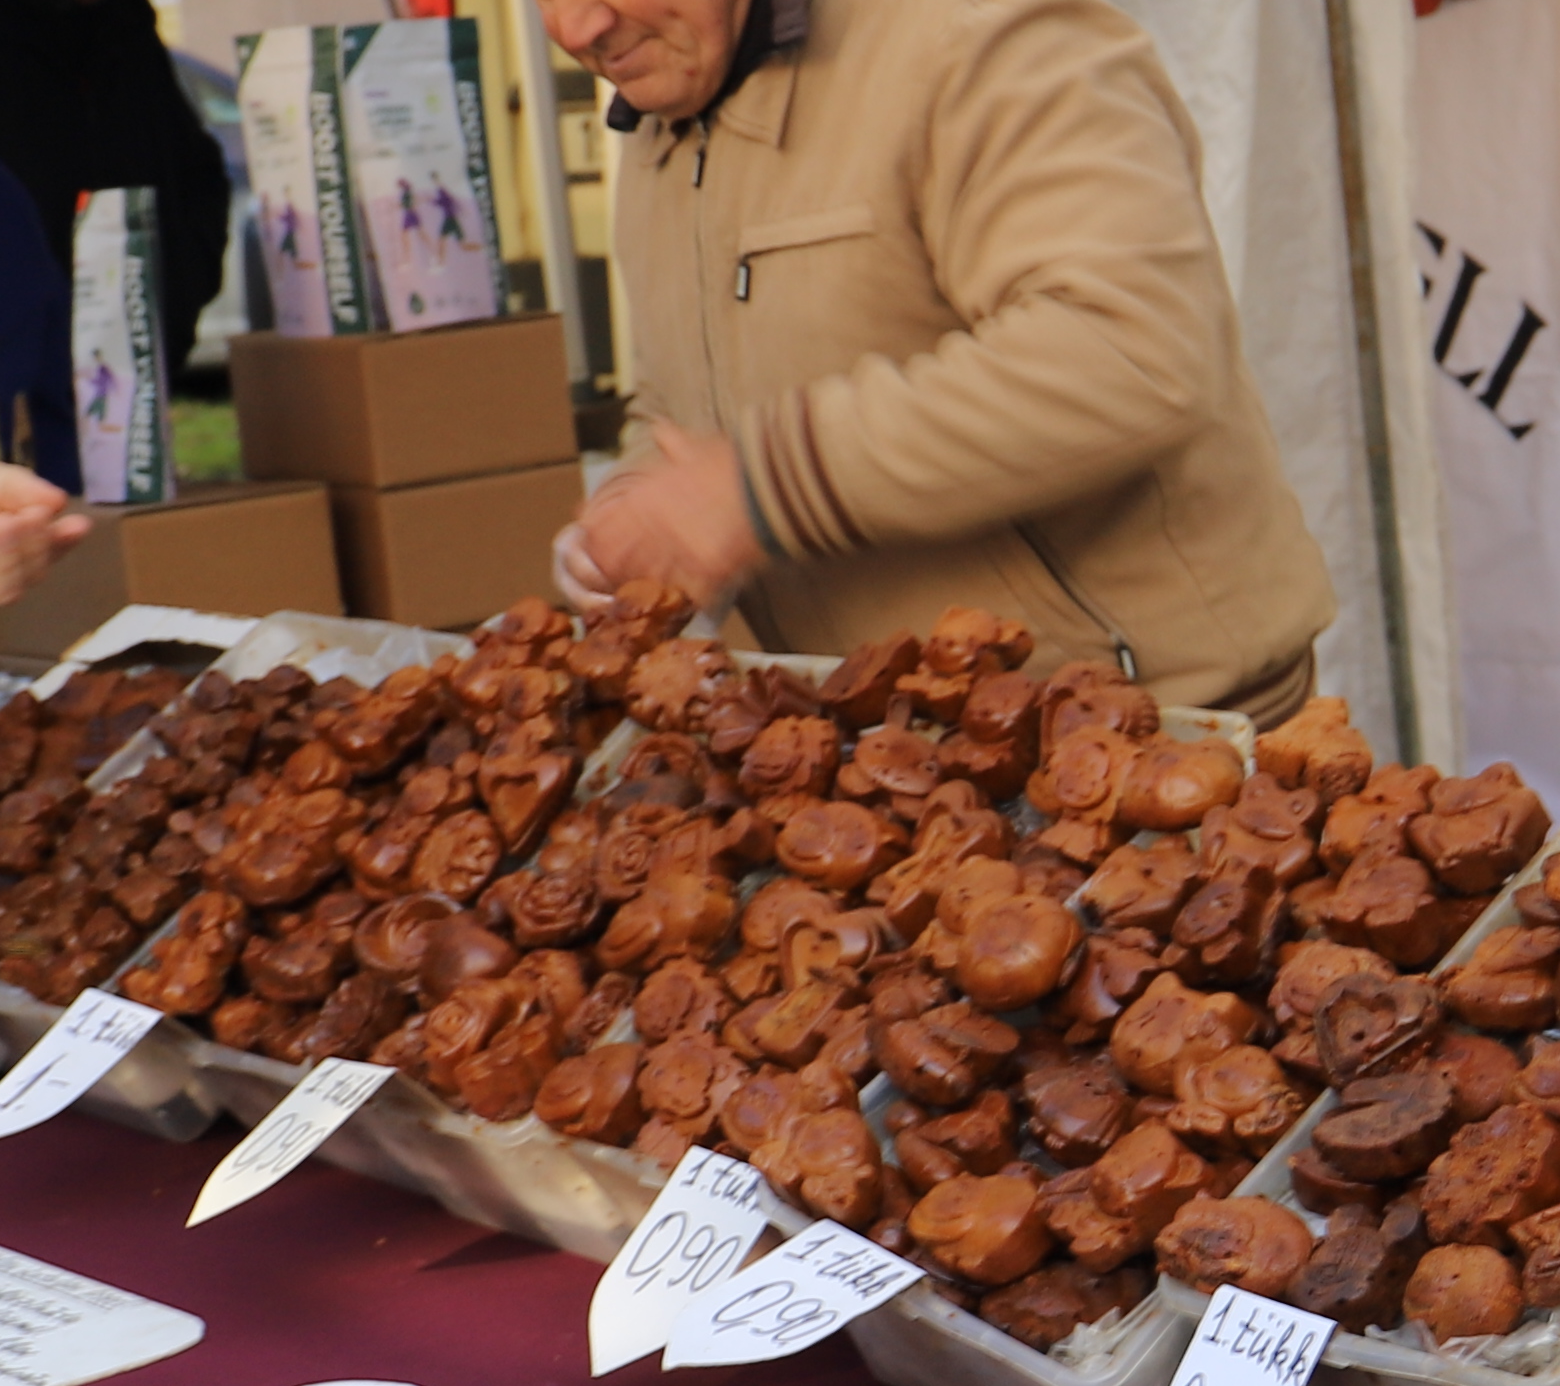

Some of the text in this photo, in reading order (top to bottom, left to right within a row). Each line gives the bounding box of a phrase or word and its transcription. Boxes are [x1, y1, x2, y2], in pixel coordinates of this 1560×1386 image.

[310, 91, 359, 325] BOOST YOURSELF
[124, 256, 157, 494] BOOST YOURSELF
[625, 1211, 742, 1295] 0,90
[711, 1280, 839, 1347] 0,90
